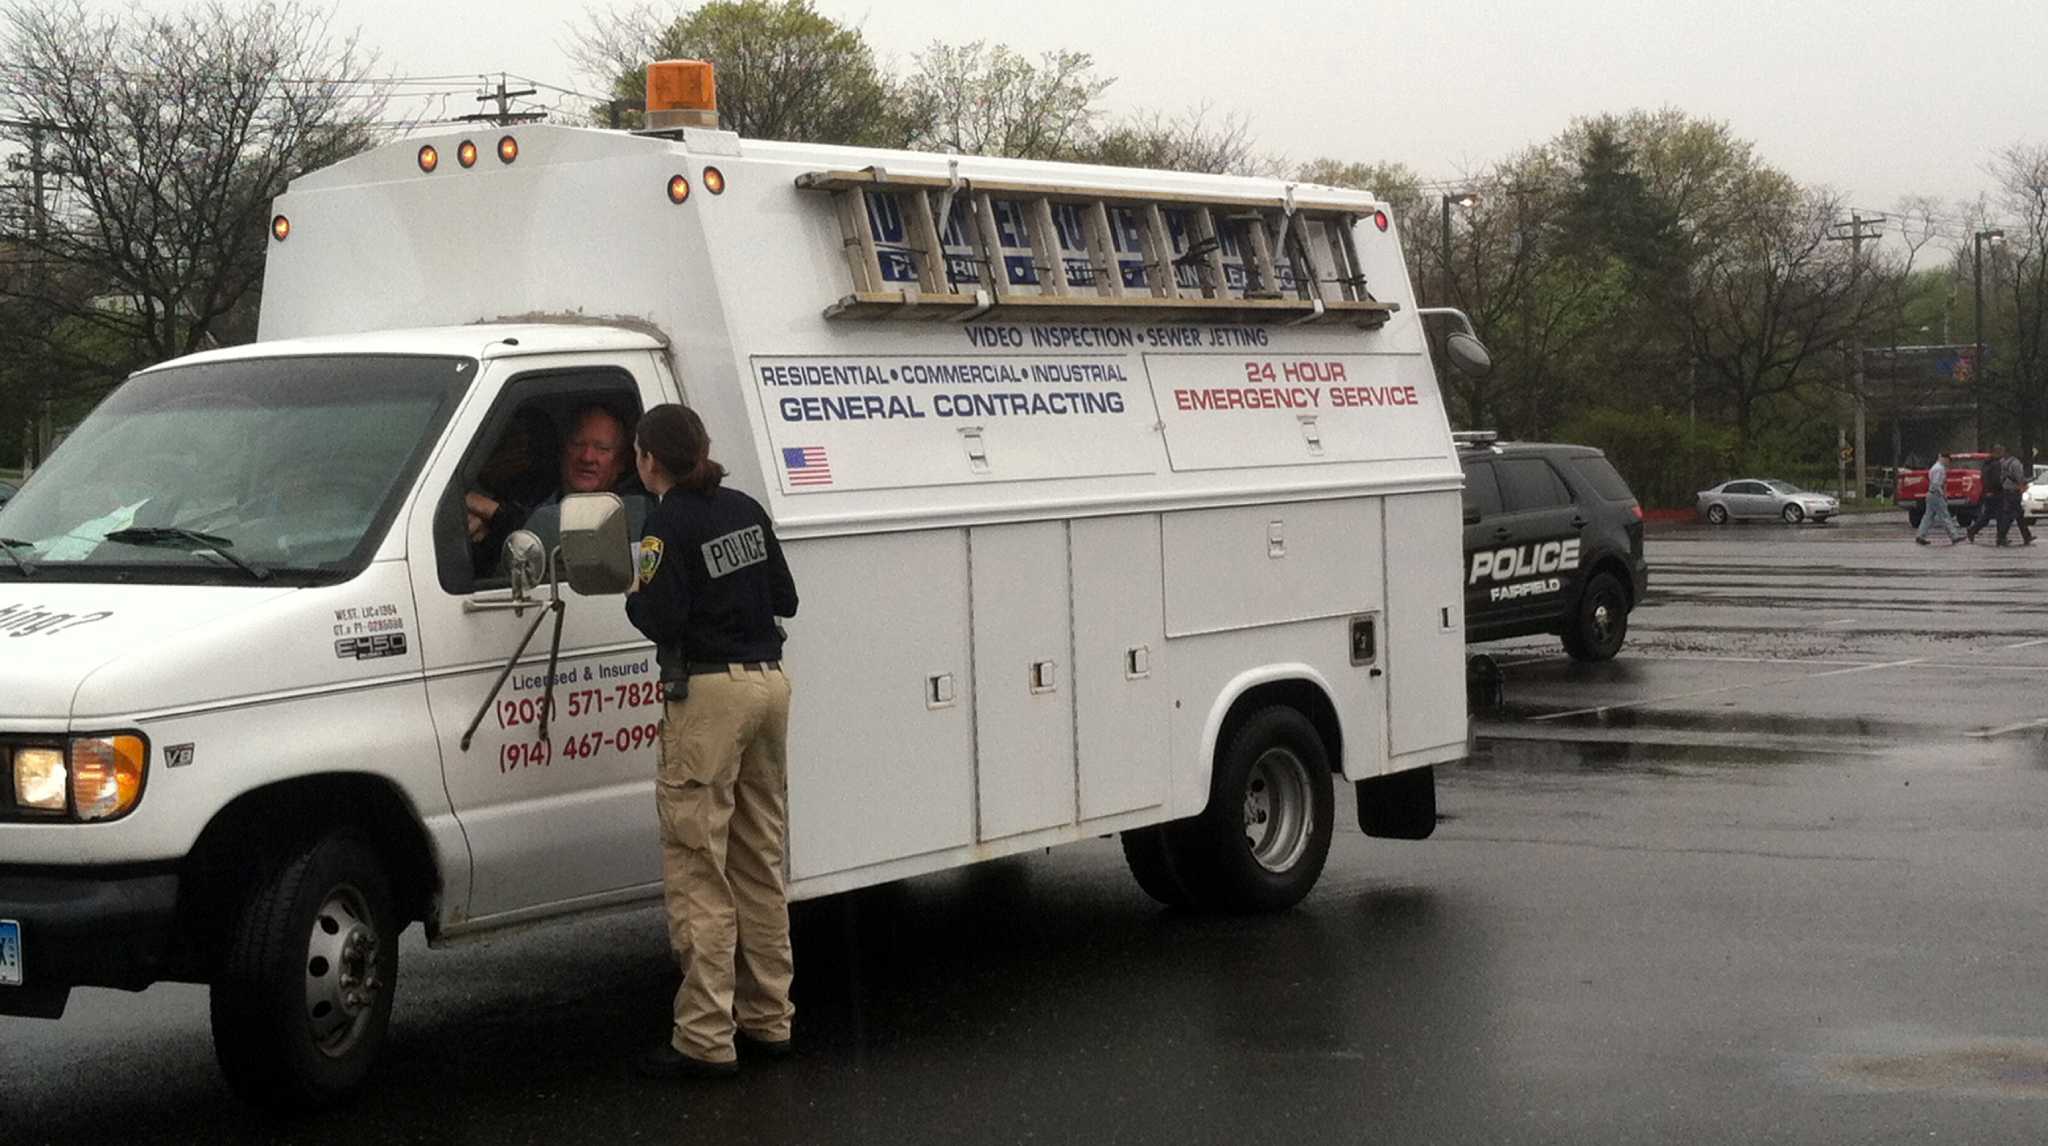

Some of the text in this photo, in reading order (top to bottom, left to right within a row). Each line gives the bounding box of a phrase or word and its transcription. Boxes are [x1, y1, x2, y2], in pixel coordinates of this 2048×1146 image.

[965, 326, 1269, 347] VIDEO INSPECTION SEWER JETTING
[760, 365, 890, 386] RESIDENTIAL
[1031, 364, 1128, 383] INDUSTRIAL
[1246, 361, 1347, 382] 24 HOUR
[779, 391, 1125, 422] GENERAL CONTRACTING
[1174, 386, 1418, 410] EMERGENCY SERVICE
[710, 529, 765, 573] POLICE
[1468, 538, 1581, 585] POLICE
[1490, 578, 1561, 602] FAIRFIELD
[335, 633, 407, 659] E450
[583, 666, 593, 682] &
[599, 659, 649, 680] Insured
[568, 680, 665, 717] 571-7828
[165, 749, 192, 768] V8
[500, 723, 660, 774] (914) 467-099
